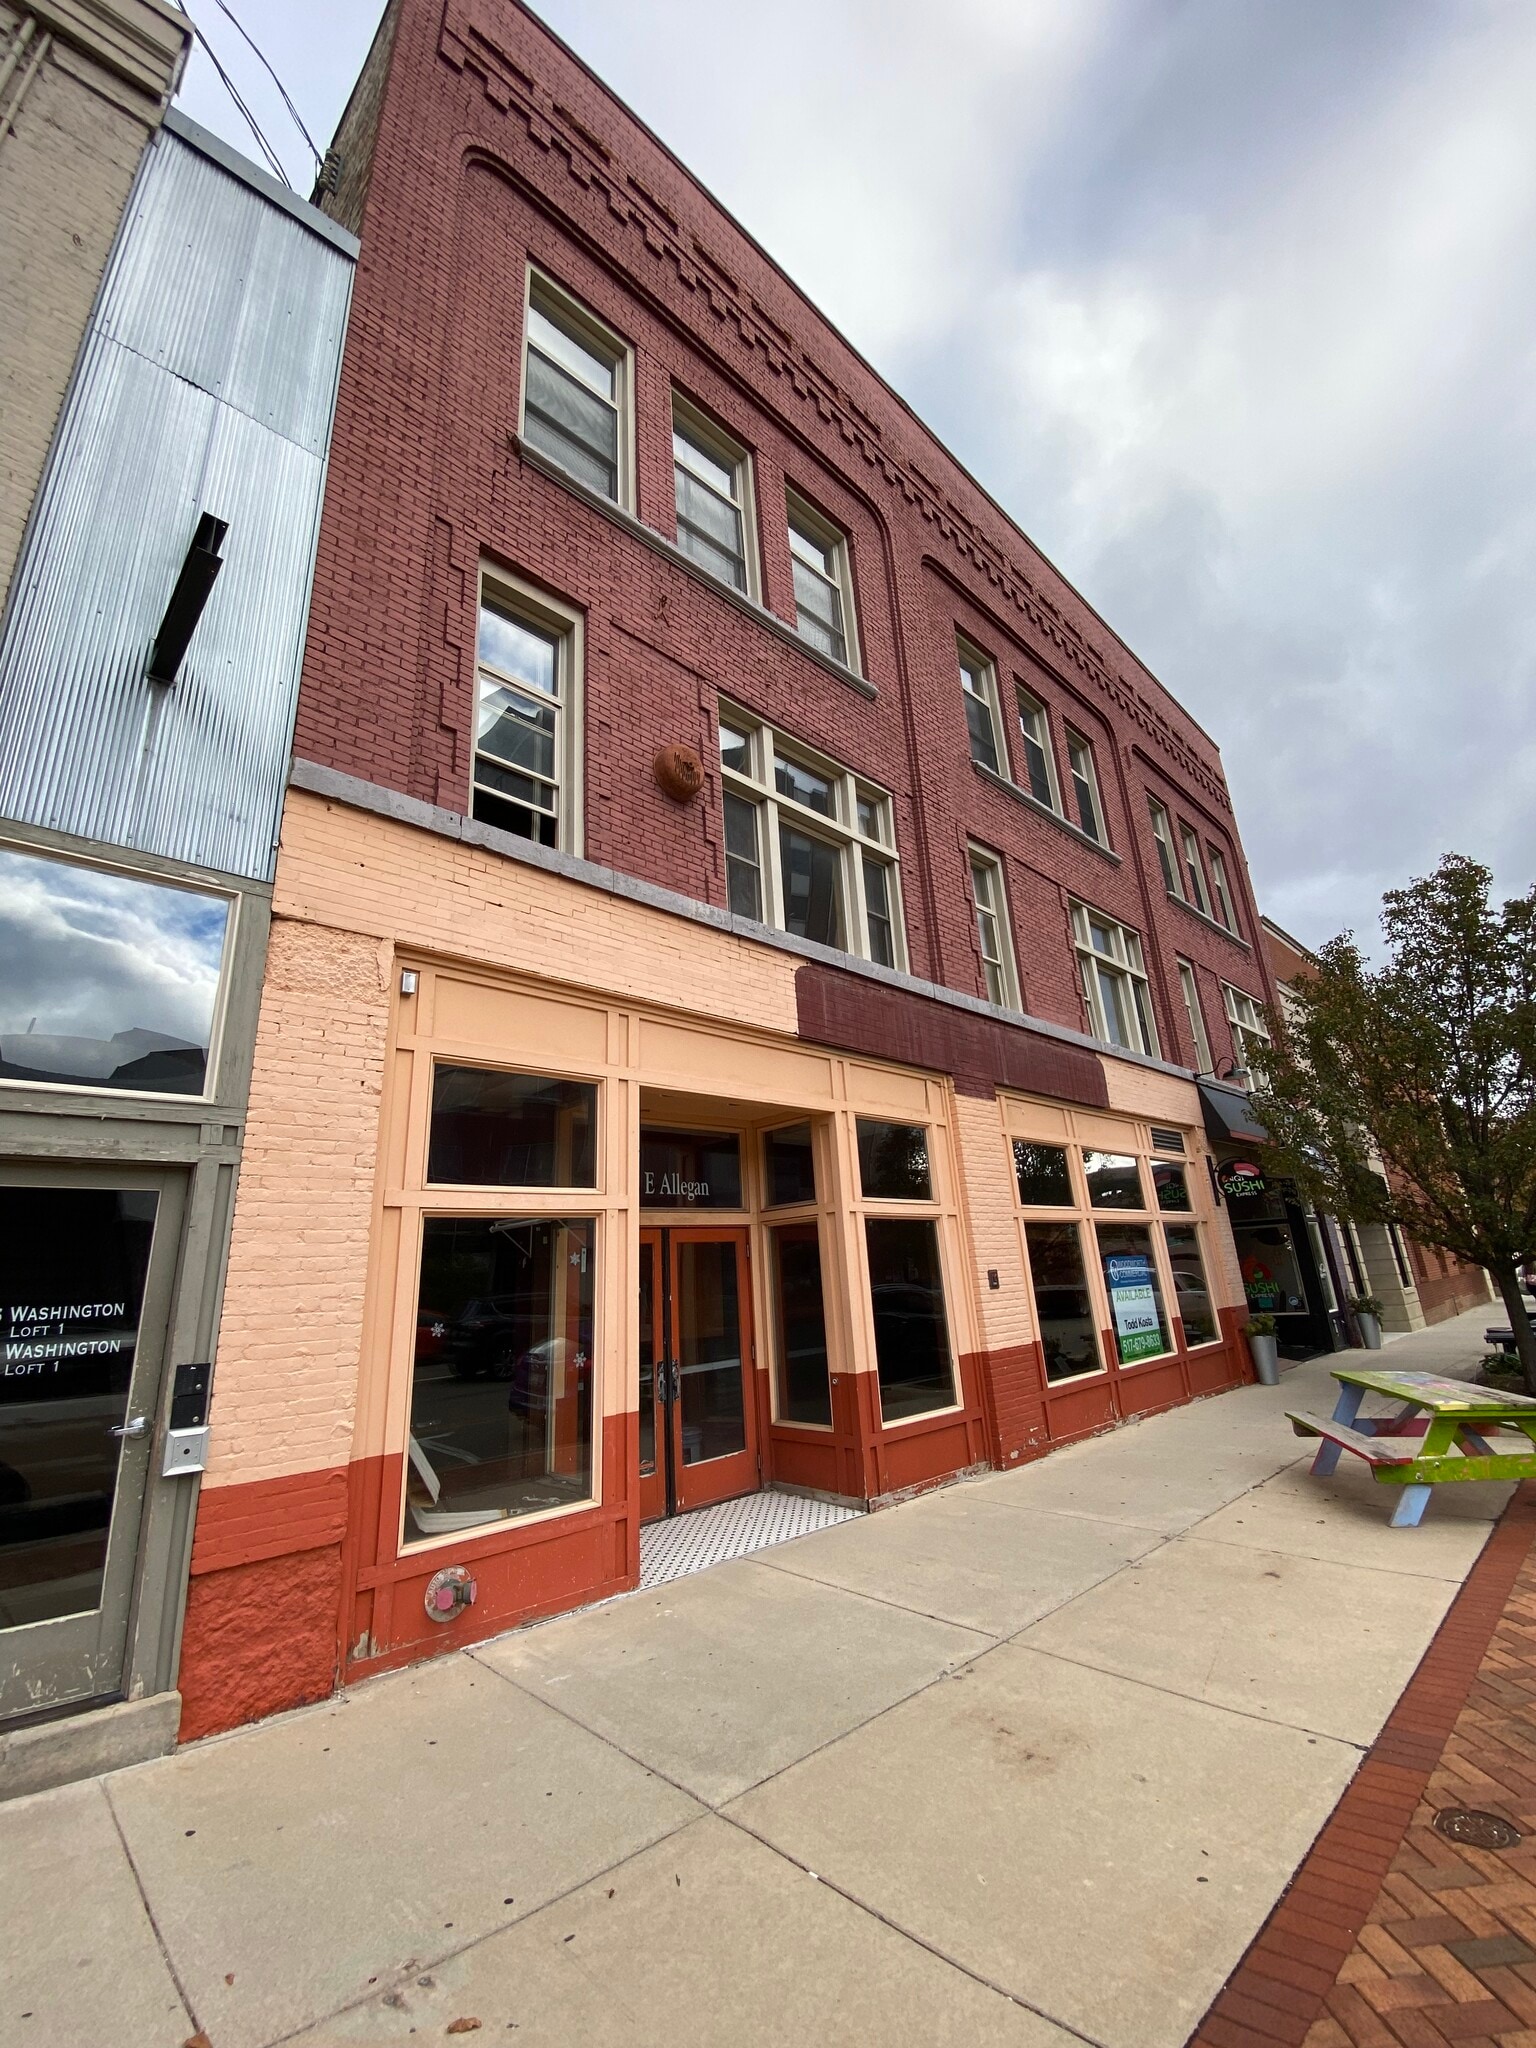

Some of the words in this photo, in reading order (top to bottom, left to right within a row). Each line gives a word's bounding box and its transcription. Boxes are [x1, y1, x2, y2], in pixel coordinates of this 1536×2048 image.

[644, 1171, 656, 1194] E
[660, 1172, 710, 1201] Allegan
[1223, 1180, 1265, 1193] SUSHI
[1116, 1288, 1152, 1302] AVAILABLE
[1244, 1282, 1280, 1295] SUSHI
[10, 1303, 125, 1322] WASHINGTON
[10, 1325, 51, 1338] LOFT
[58, 1322, 65, 1335] 1
[1124, 1317, 1139, 1330] Todd
[1138, 1316, 1154, 1328] Kosta
[5, 1340, 121, 1360] WASHINGTON
[4, 1363, 46, 1376] LOFT
[53, 1360, 60, 1373] 1
